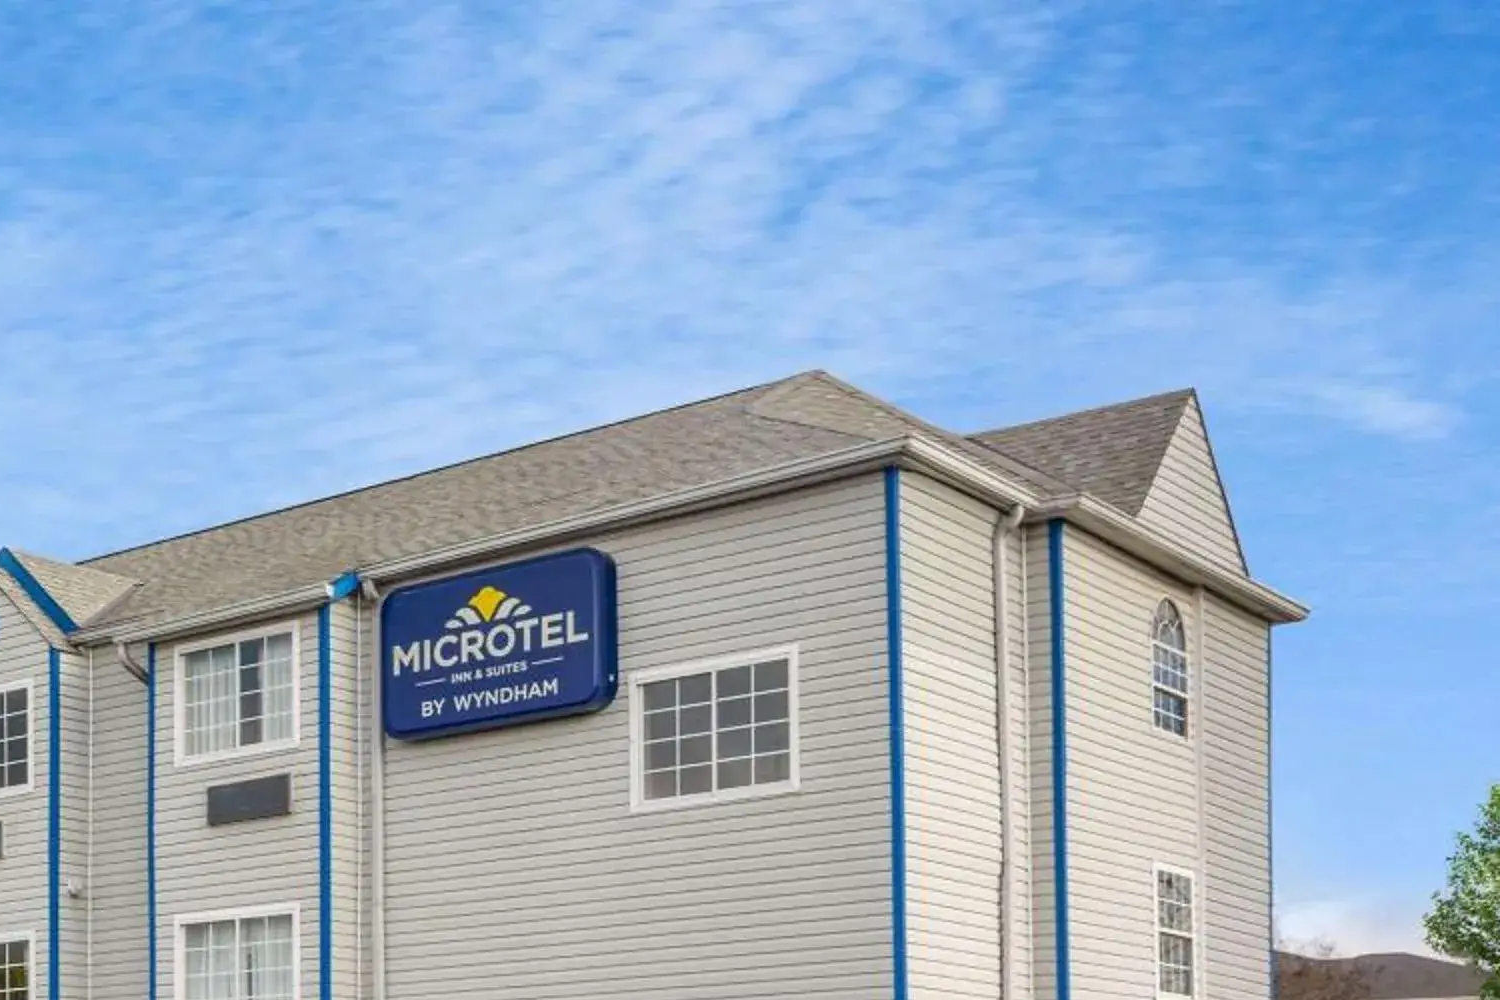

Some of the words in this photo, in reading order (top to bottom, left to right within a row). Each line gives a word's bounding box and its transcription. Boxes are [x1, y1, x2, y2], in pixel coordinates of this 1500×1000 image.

[392, 610, 589, 676] MICROTEL
[451, 671, 473, 684] INN
[474, 667, 484, 680] &
[485, 660, 528, 678] SUITES
[420, 697, 445, 718] BY
[453, 677, 560, 713] WYNDHAM
